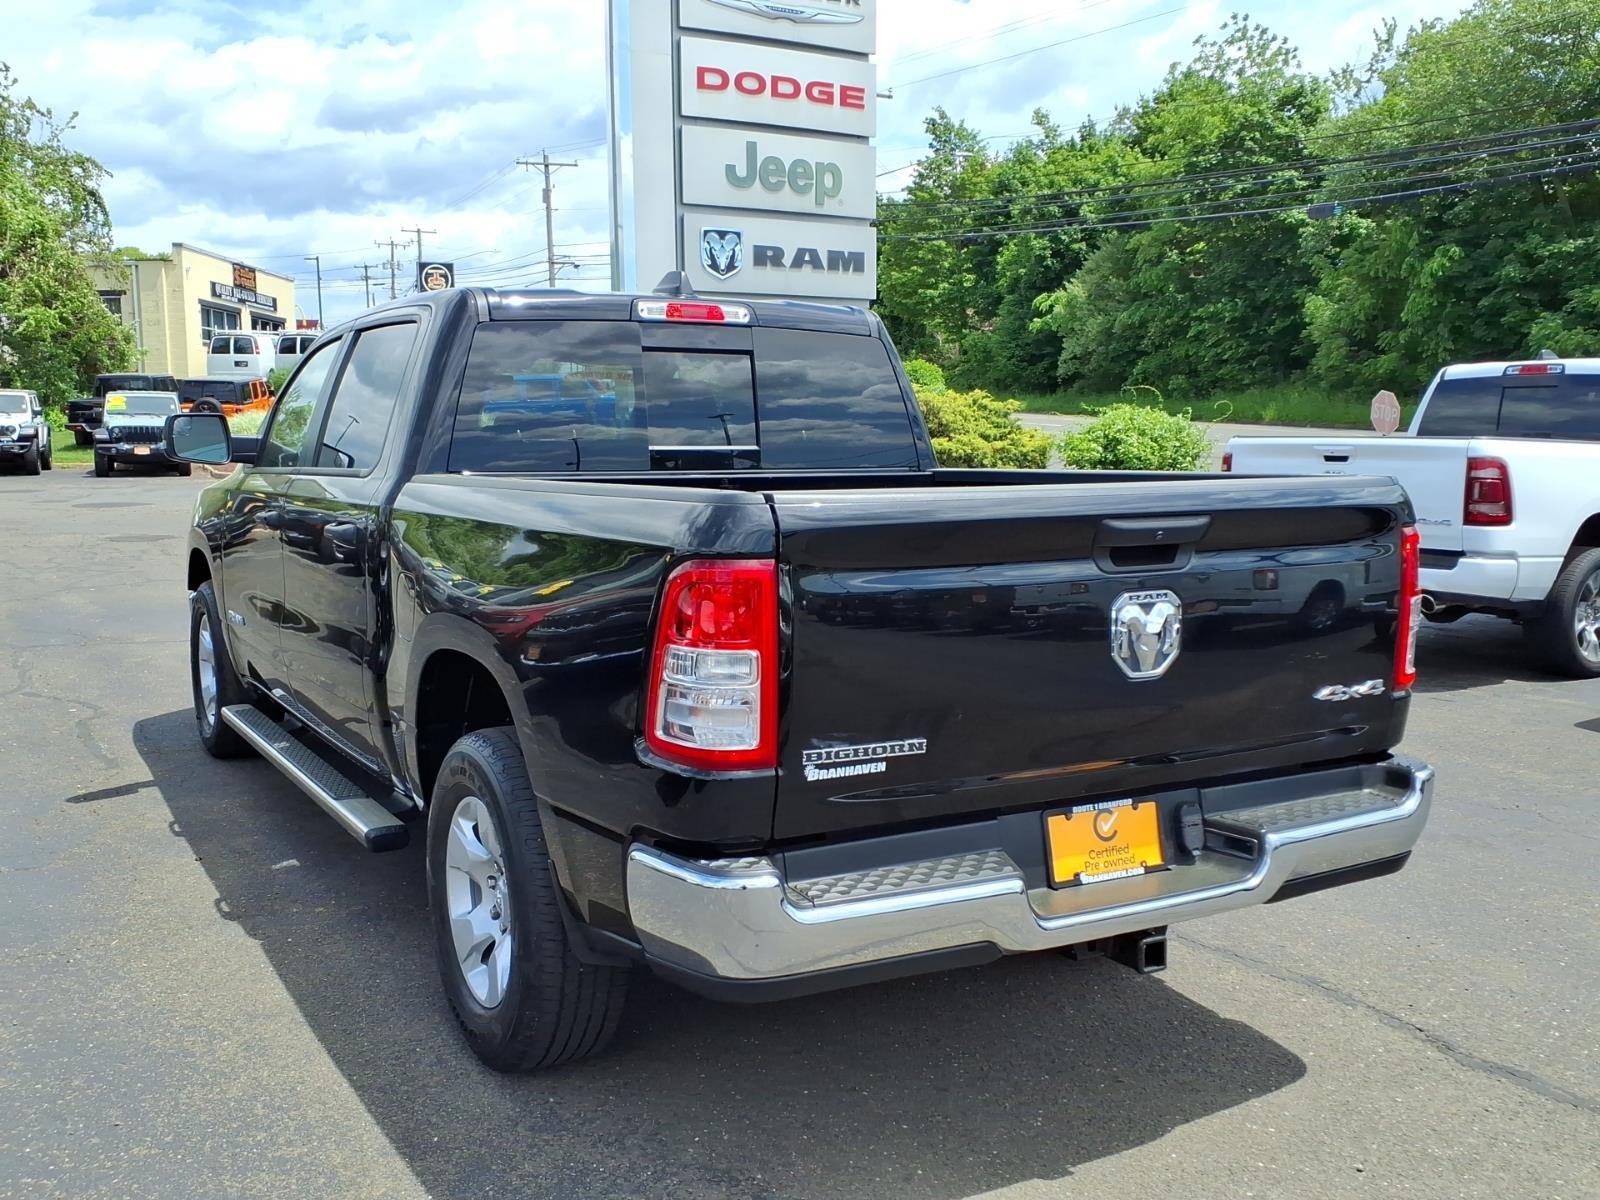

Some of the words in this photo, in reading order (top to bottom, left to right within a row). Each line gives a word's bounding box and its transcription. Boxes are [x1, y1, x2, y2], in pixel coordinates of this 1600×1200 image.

[696, 66, 865, 109] DODGE
[725, 141, 843, 206] Jeep
[753, 244, 865, 273] RAM
[1374, 403, 1398, 421] STOP
[1129, 592, 1168, 601] RAM
[803, 739, 927, 765] BIGHORN
[805, 762, 887, 781] BRANHAVEN
[1088, 843, 1130, 860] Certified
[1085, 860, 1100, 872] Pre
[1103, 854, 1136, 869] owned
